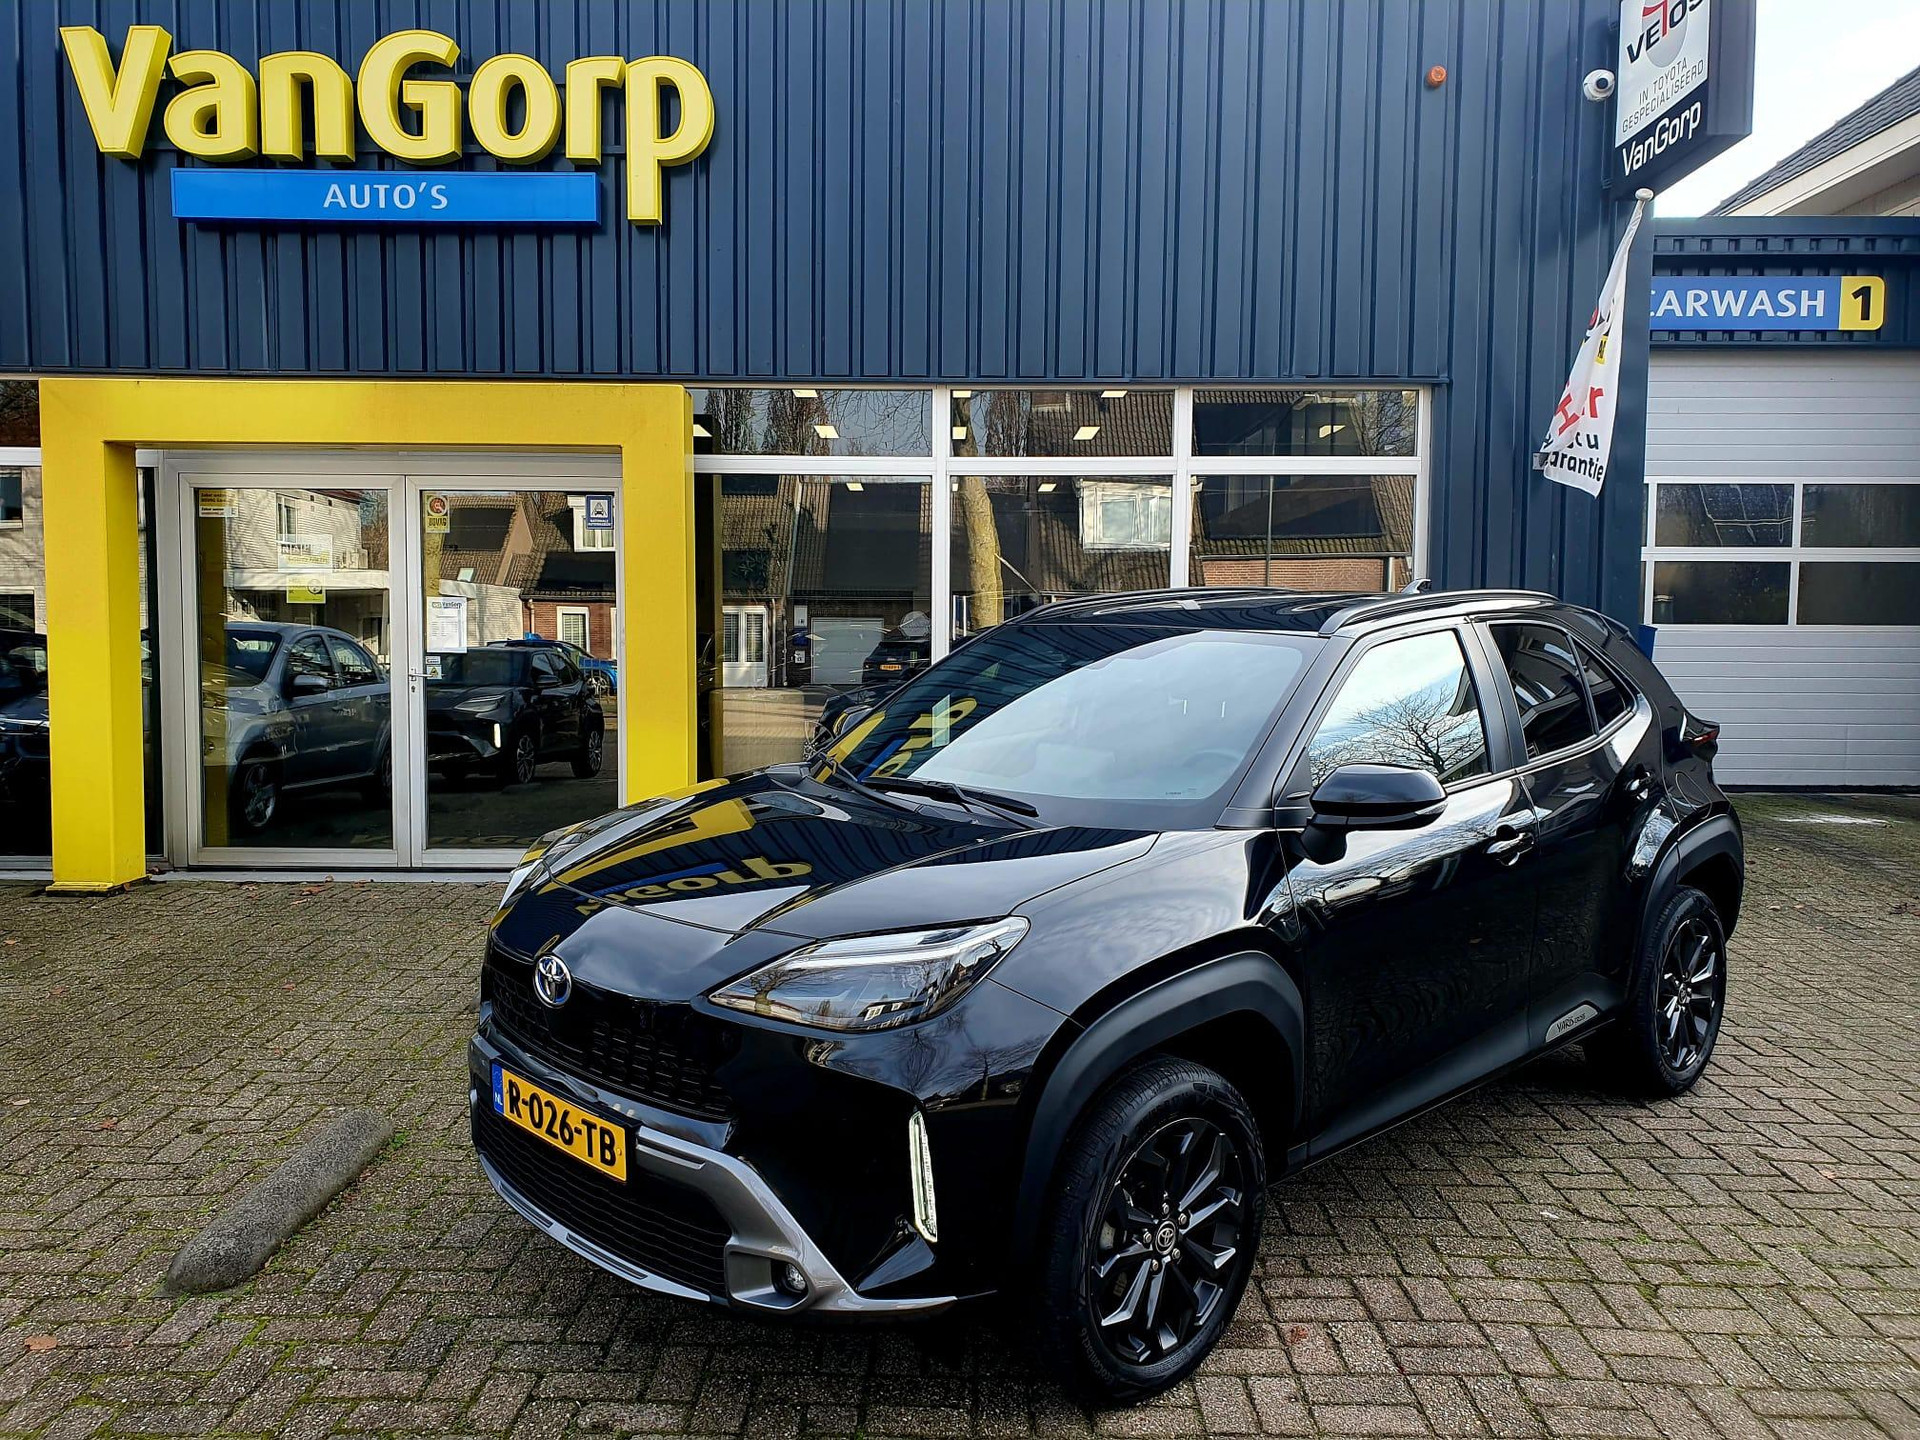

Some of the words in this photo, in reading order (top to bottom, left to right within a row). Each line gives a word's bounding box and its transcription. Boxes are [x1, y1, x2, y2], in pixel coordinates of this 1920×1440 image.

[1622, 59, 1704, 134] GESPECIALISEERD
[1639, 87, 1649, 106] IN
[1652, 57, 1689, 94] TOYOTA
[60, 25, 715, 226] VanGorp
[1622, 101, 1701, 177] VanGorp
[323, 183, 449, 210] AUTO'S
[1650, 289, 1825, 317] ARWASH
[1851, 286, 1873, 321] 1
[508, 1078, 617, 1167] R-026-TB
